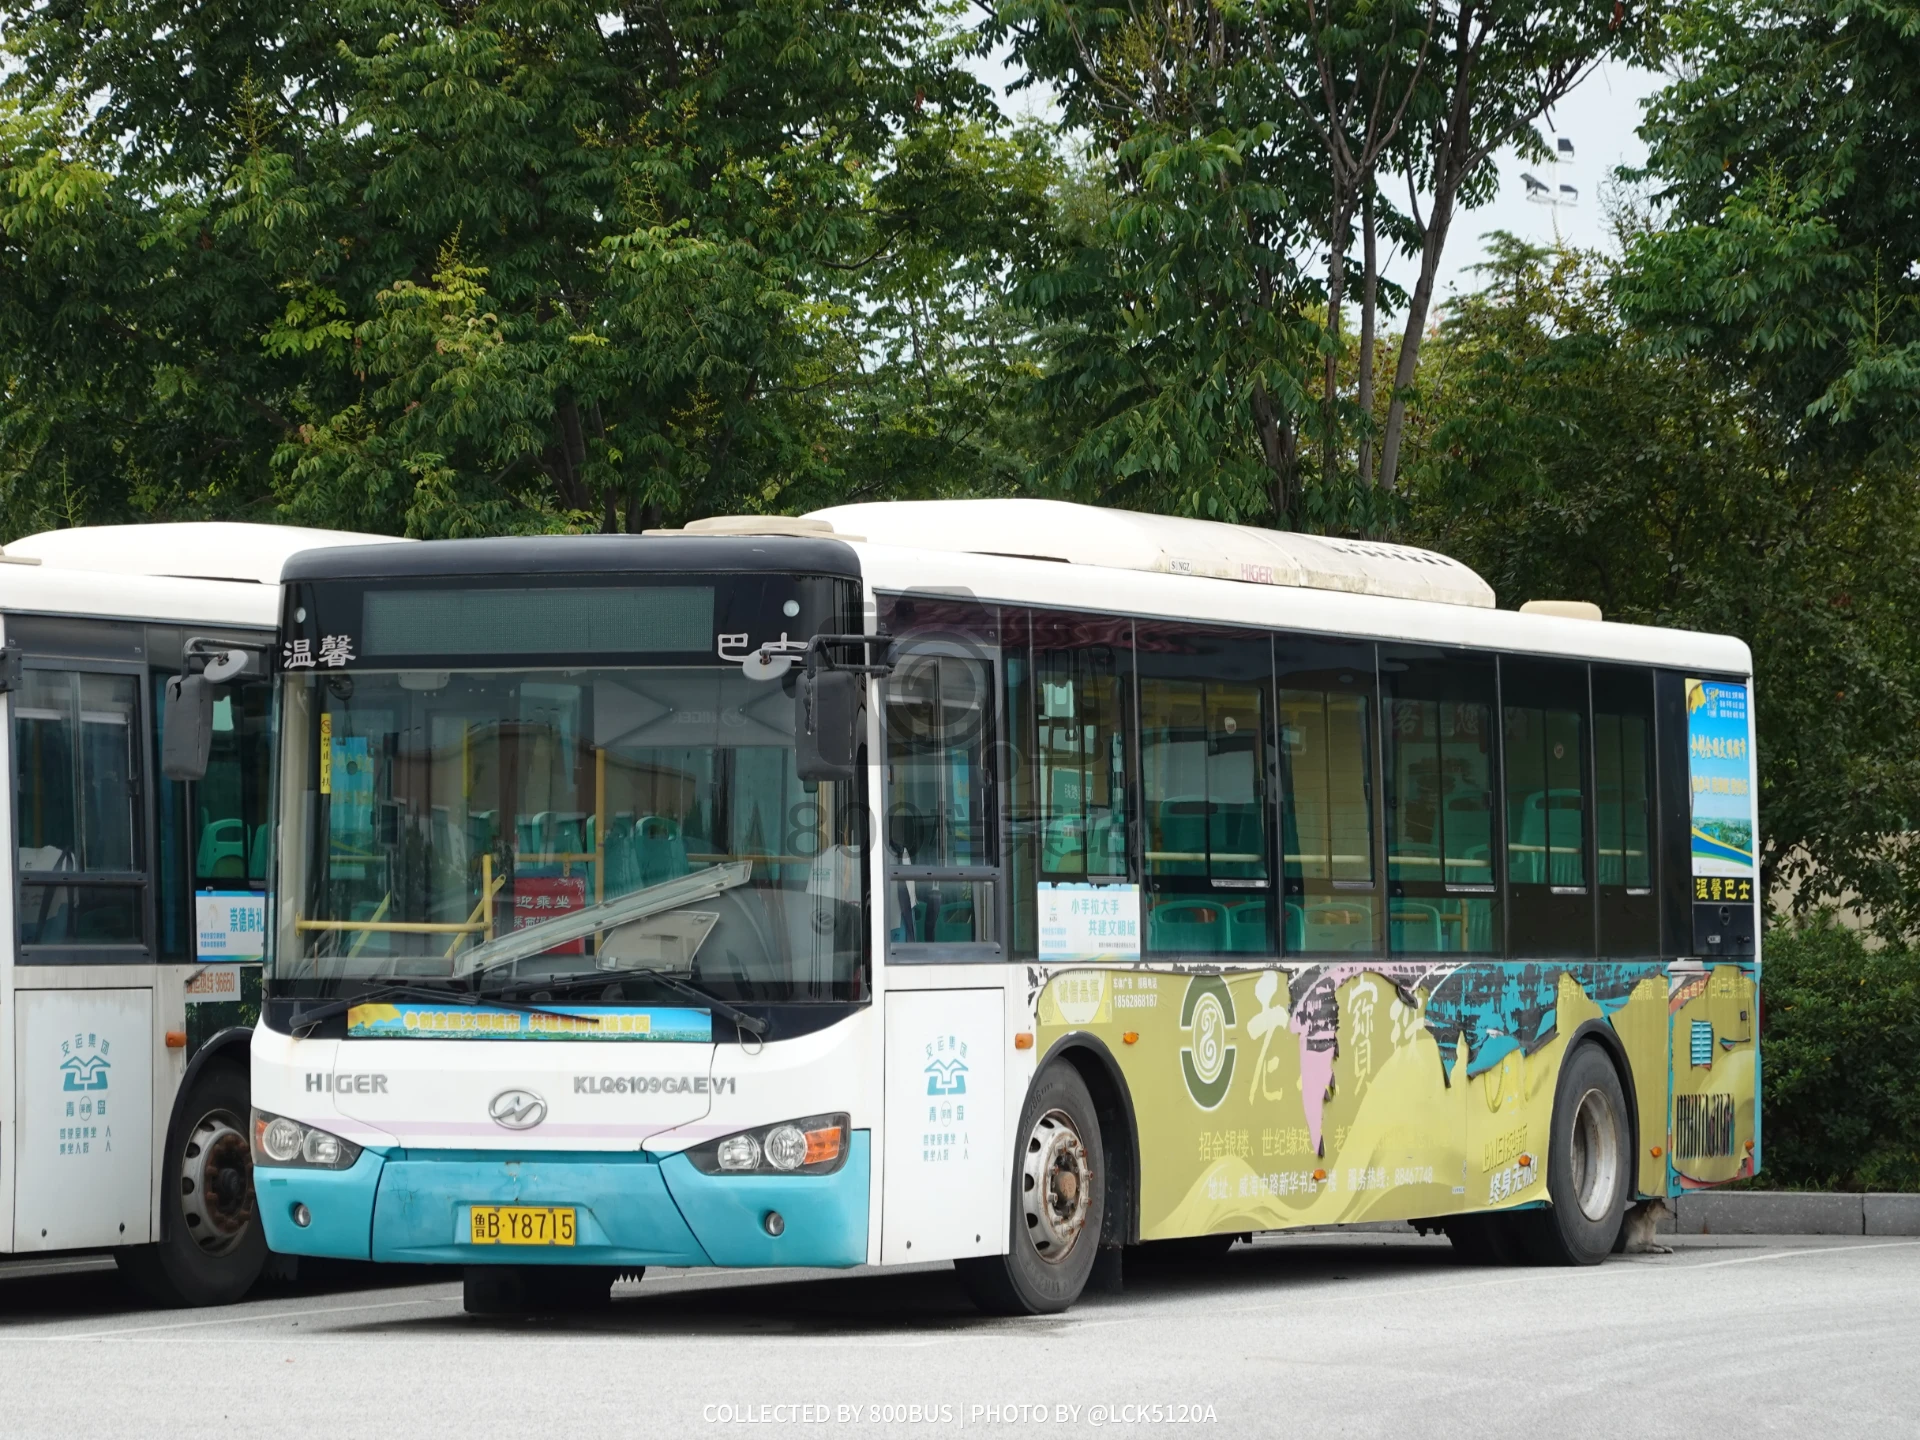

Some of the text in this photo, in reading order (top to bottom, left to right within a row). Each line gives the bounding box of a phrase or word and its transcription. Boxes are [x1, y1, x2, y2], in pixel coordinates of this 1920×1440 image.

[1171, 561, 1190, 571] SNGZ
[1241, 563, 1274, 584] HIGER
[283, 634, 356, 669] 温馨
[1696, 877, 1750, 900] 温馨巴士
[1071, 898, 1119, 915] 小手拉大手
[230, 906, 264, 932] 崇德尚礼
[1088, 919, 1136, 937] 共建文明城
[1114, 994, 1157, 1008] 18562868187
[61, 1033, 110, 1058] 交运集团
[926, 1035, 967, 1060] 交运集团
[305, 1073, 736, 1095] HIGER KLQ6109GAEV1
